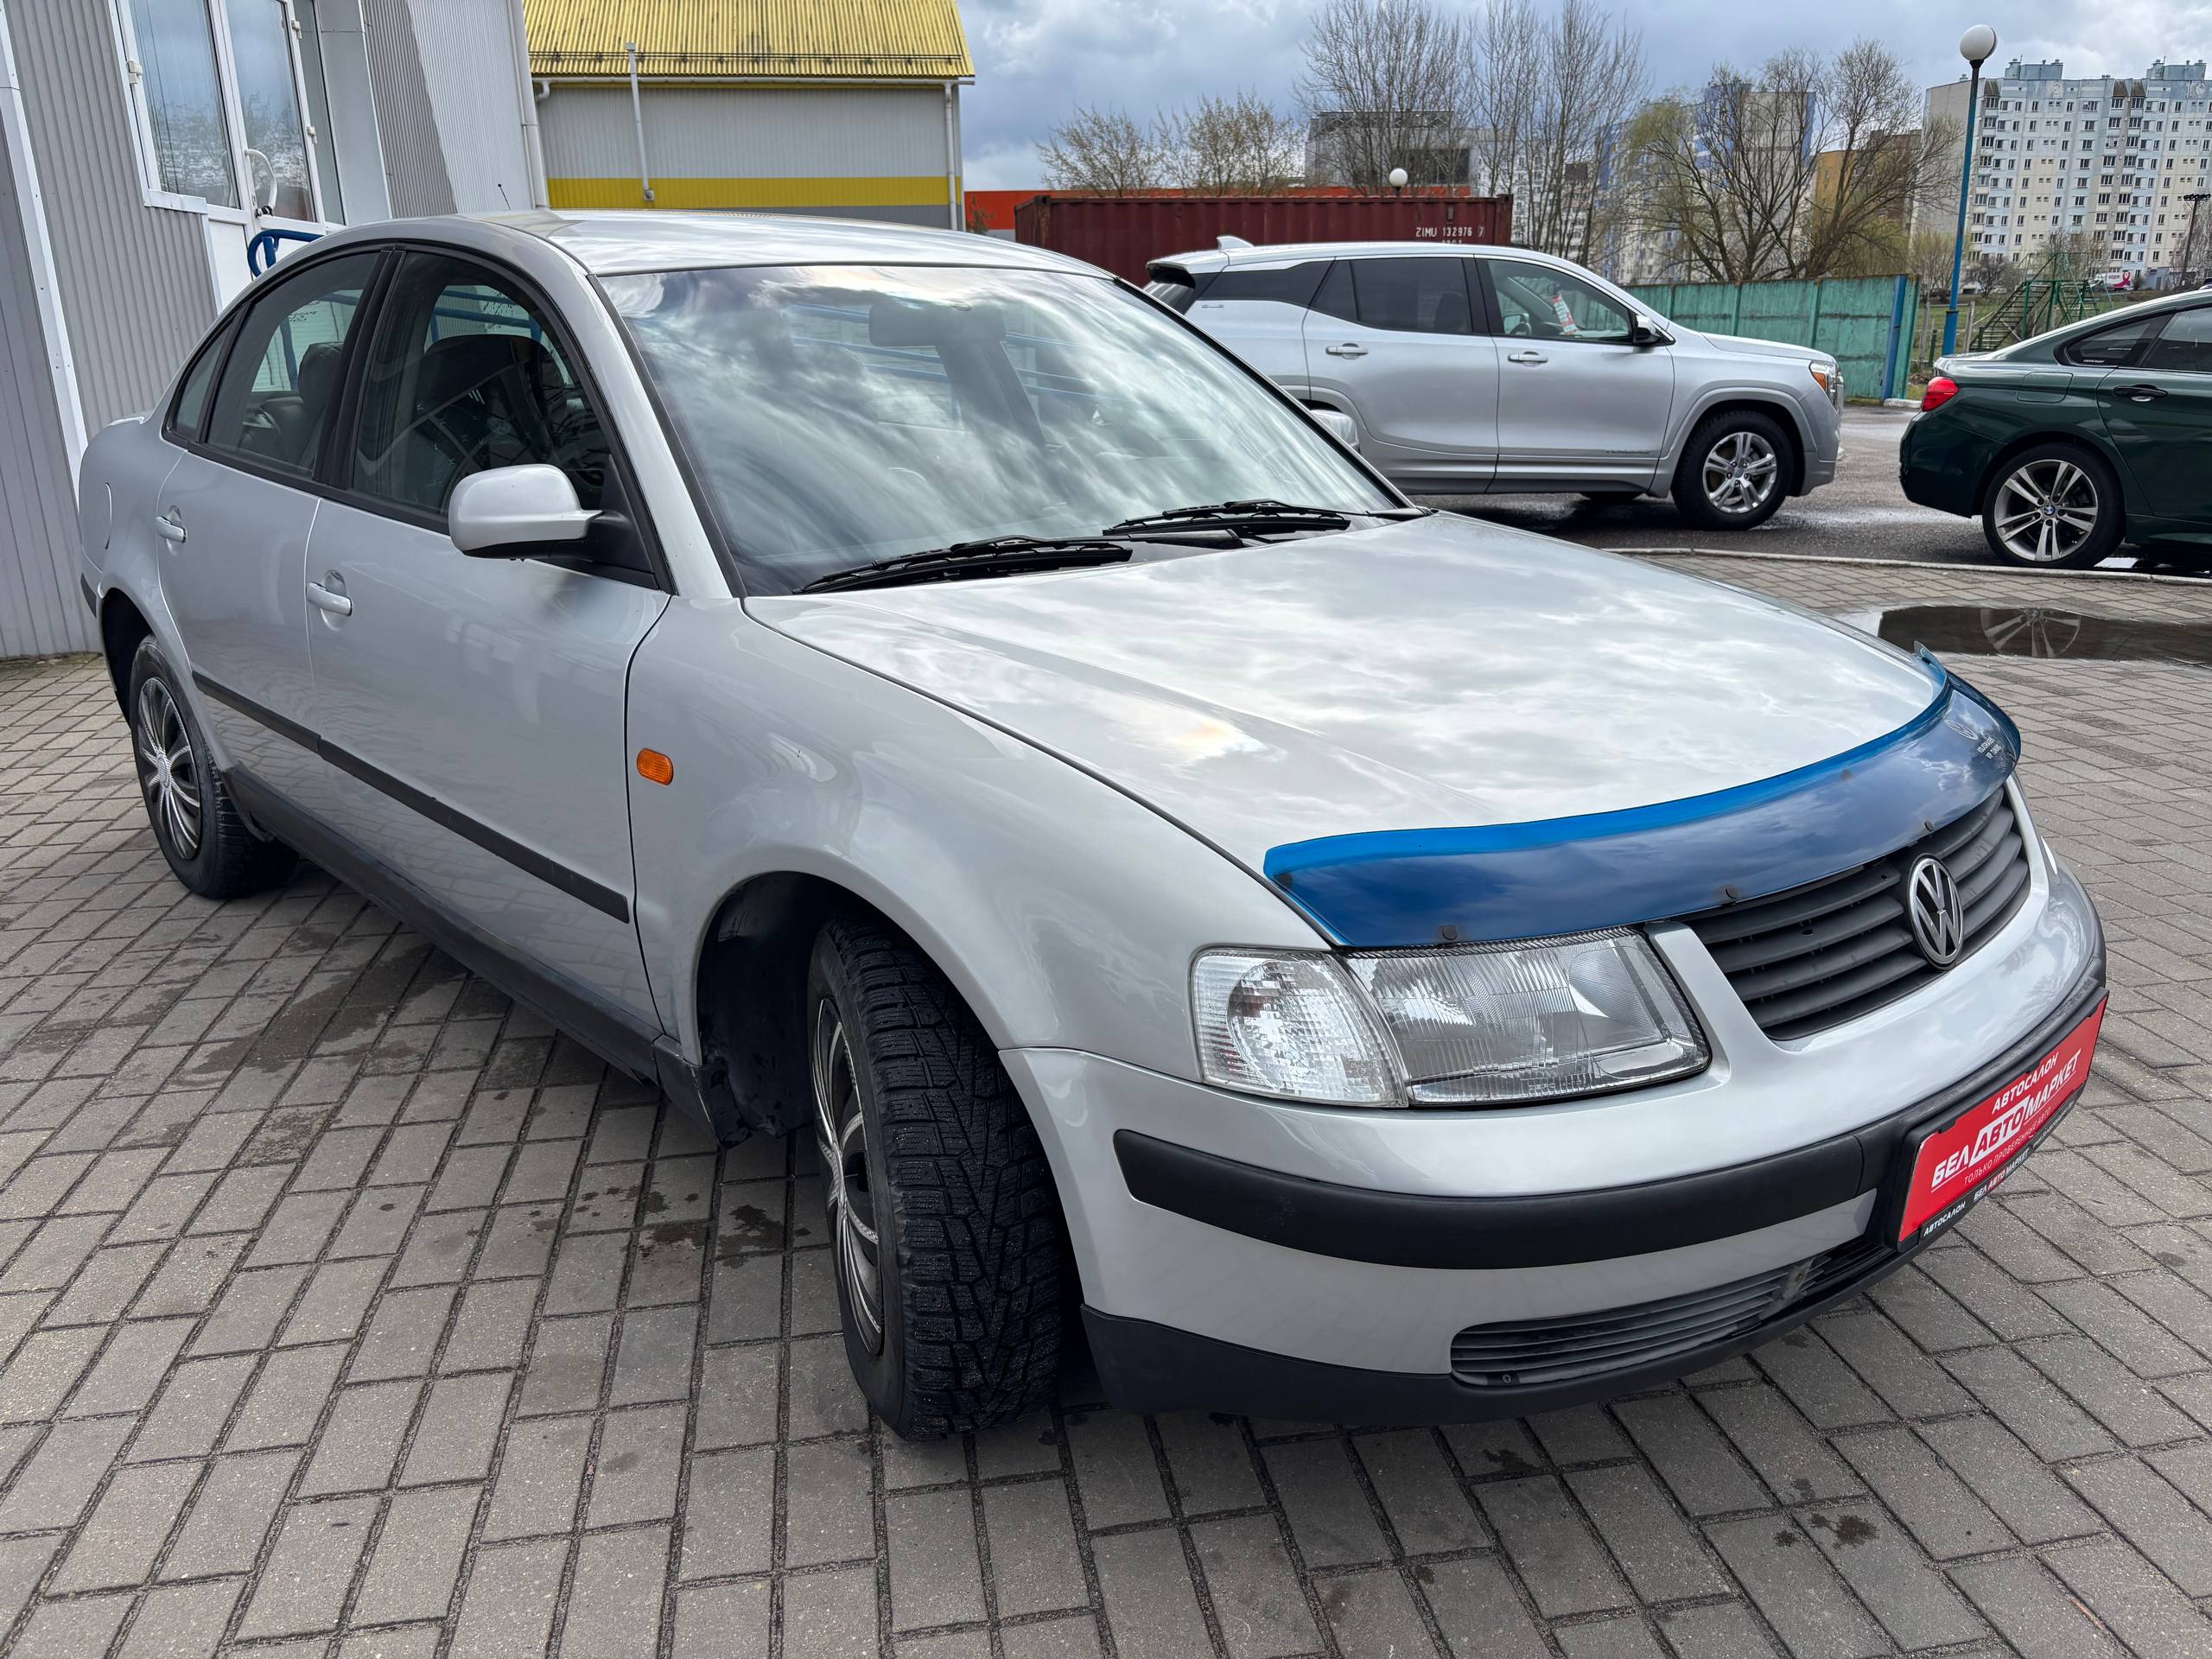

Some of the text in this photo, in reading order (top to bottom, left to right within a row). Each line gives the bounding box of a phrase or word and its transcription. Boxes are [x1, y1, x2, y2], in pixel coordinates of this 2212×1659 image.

[1415, 226, 1438, 238] ZIMU
[1442, 226, 1473, 238] 132976
[1992, 1052, 2059, 1115] АВТОСАЛОН
[1964, 1160, 1993, 1186] ТОЛЬКО
[1923, 1201, 1967, 1237] АВТОСАЛОН
